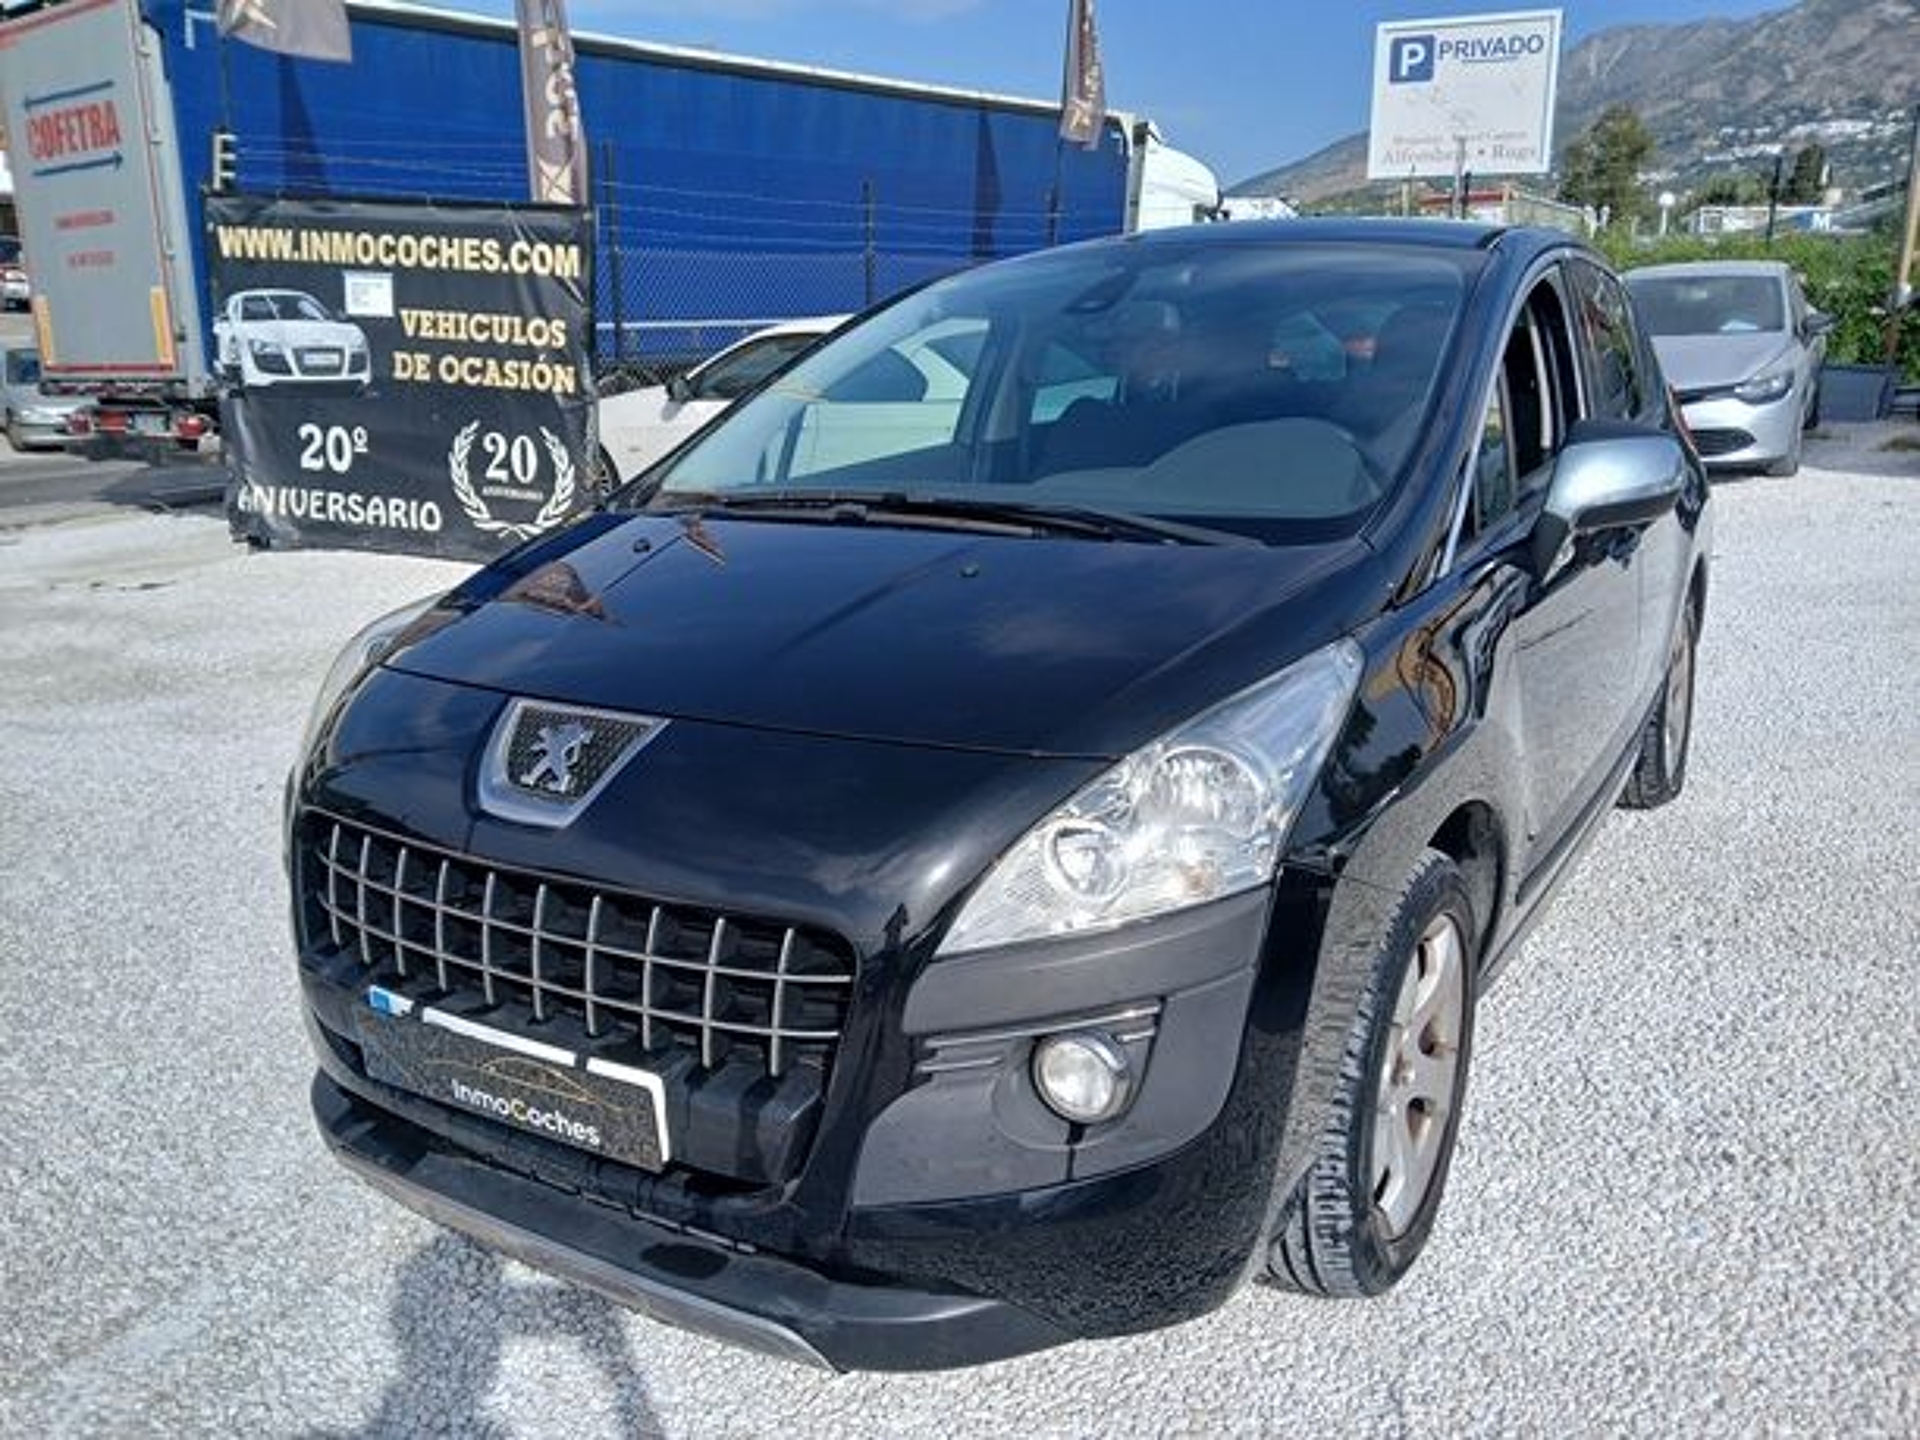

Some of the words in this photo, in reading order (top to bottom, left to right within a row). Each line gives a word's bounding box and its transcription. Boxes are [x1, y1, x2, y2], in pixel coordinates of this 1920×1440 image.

[1401, 43, 1426, 77] P
[1438, 34, 1544, 61] PRIVADO
[26, 100, 121, 161] COFETRA
[217, 225, 580, 277] WWW.INMOCOCHES.COM
[400, 309, 567, 348] VEHICULOS
[393, 352, 430, 381] DE
[439, 354, 575, 393] OCASIÓN
[482, 432, 538, 484] 20
[451, 1078, 600, 1146] InmoCoches
